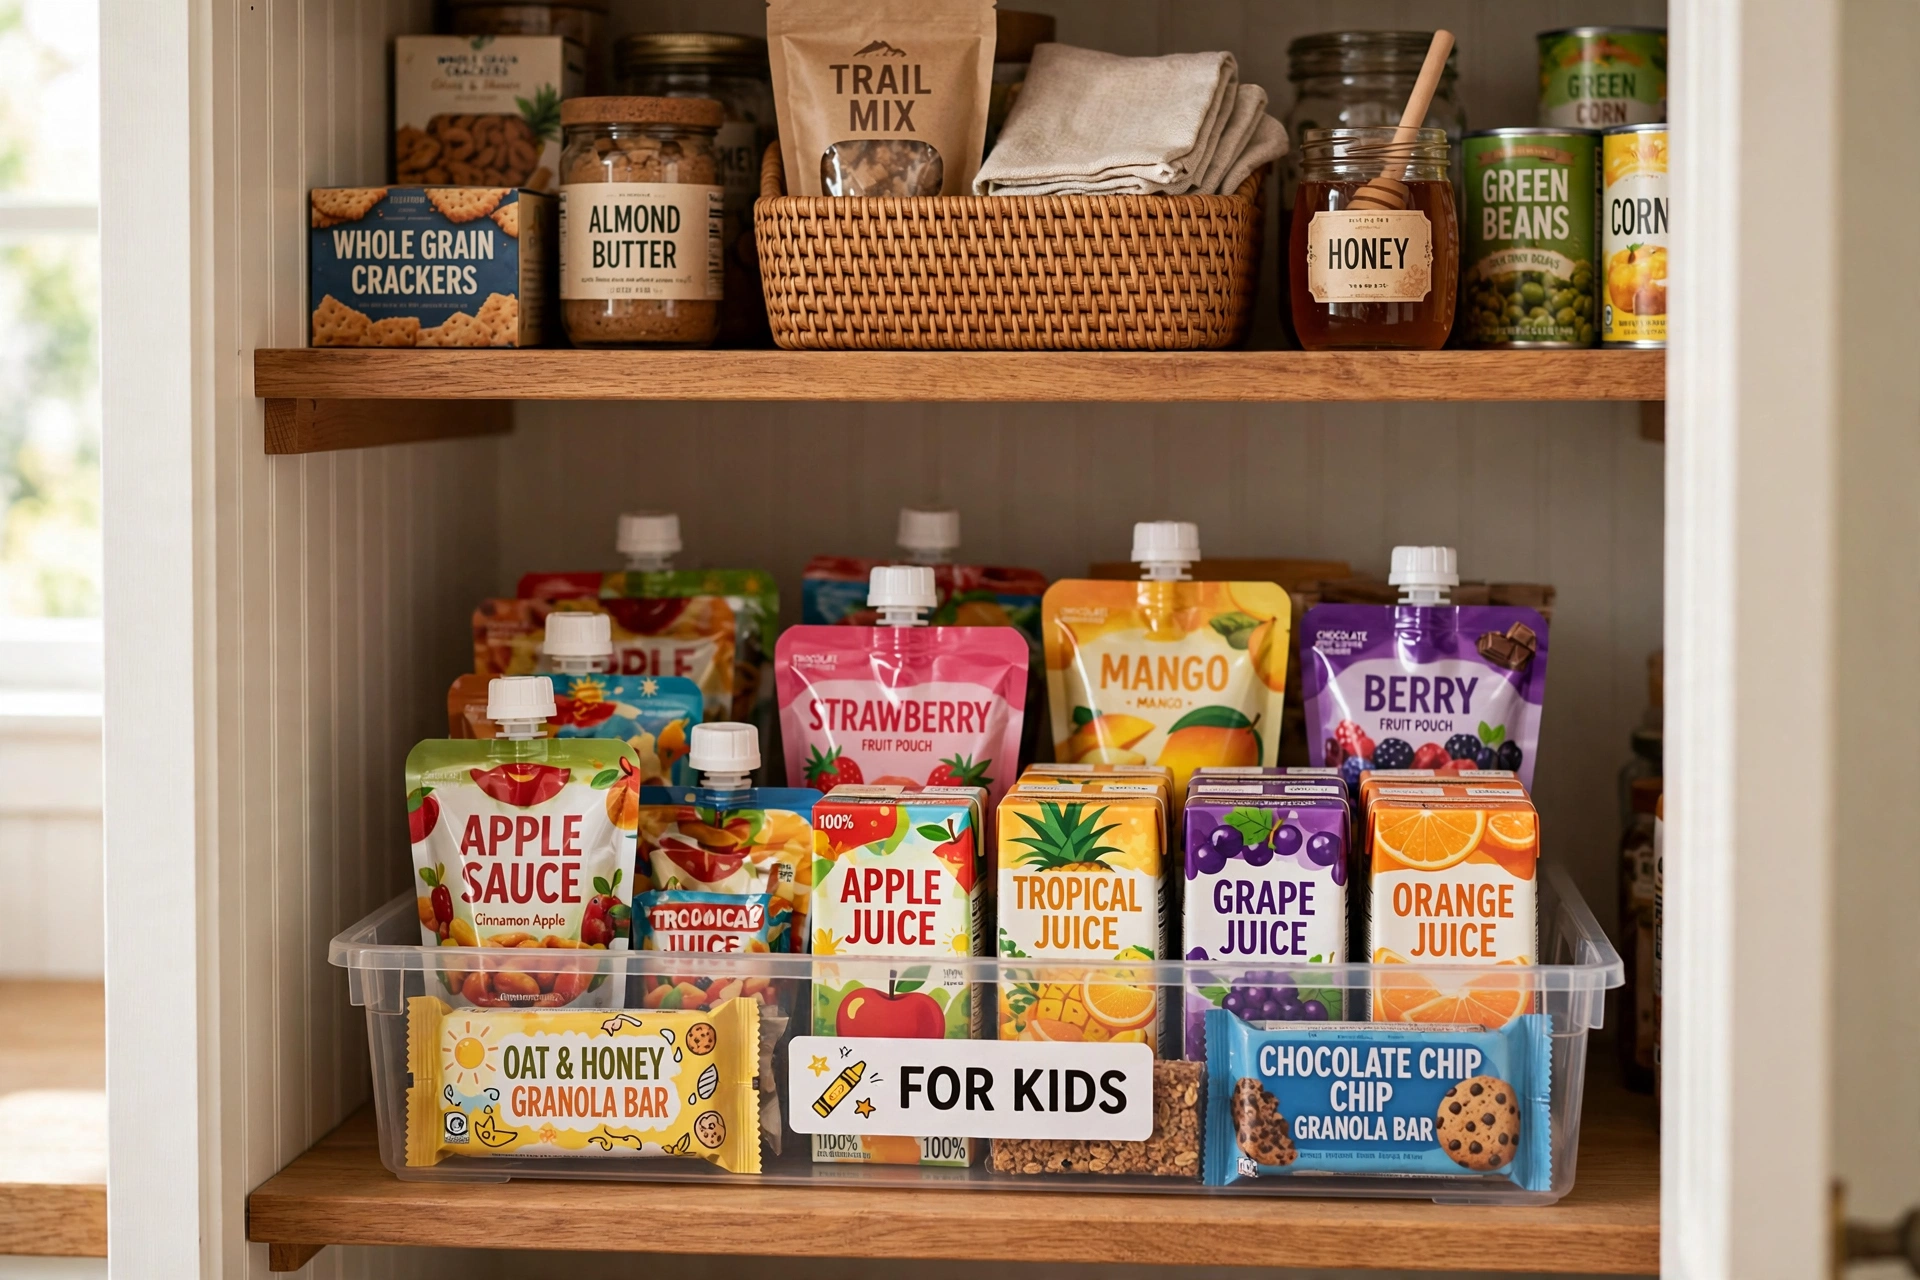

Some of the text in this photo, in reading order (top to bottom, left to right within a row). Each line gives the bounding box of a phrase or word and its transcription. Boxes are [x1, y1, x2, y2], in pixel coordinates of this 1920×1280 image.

[829, 64, 931, 95] TRAIL
[1567, 73, 1636, 99] GREEN
[850, 100, 916, 132] MIX
[1576, 102, 1627, 124] CORN
[1482, 168, 1569, 203] GREEN
[589, 205, 681, 233] ALMOND
[1483, 205, 1570, 240] BEANS
[1611, 197, 1668, 236] CORN
[332, 230, 494, 260] WHOLE GRAIN
[593, 240, 677, 268] BUTTER
[1328, 237, 1410, 269] HONEY
[352, 265, 477, 295] CRACKERS
[1102, 653, 1228, 692] MANGO
[1137, 698, 1182, 709] MANGO
[1364, 674, 1478, 715] BERRY
[809, 699, 992, 734] STRAWBERRY
[1380, 718, 1453, 732] FRUIT POUCH
[862, 739, 932, 752] FRUIT POUCH
[460, 814, 582, 857] APPLE
[818, 814, 854, 829] 100%
[461, 862, 581, 904] SAUCE
[840, 868, 941, 905] APPLE
[1013, 875, 1142, 913] TROPICAL
[1213, 879, 1315, 916] GRAPE
[1393, 882, 1514, 919] ORANGE
[475, 913, 566, 930] Cinnamon Apple
[845, 909, 936, 946] JUICE
[1034, 915, 1120, 950] JUICE
[1219, 920, 1307, 956] JUICE
[1410, 922, 1497, 958] JUICE
[504, 1045, 665, 1080] OAT & HONEY
[1260, 1045, 1482, 1080] CHOCOLATE CHIP
[511, 1085, 669, 1118] GRANOLA BAR
[899, 1066, 1128, 1114] FOR KIDS
[1330, 1080, 1393, 1113] CHIP
[1294, 1116, 1433, 1142] GRANOLA BAR
[923, 1136, 966, 1159] 100%
